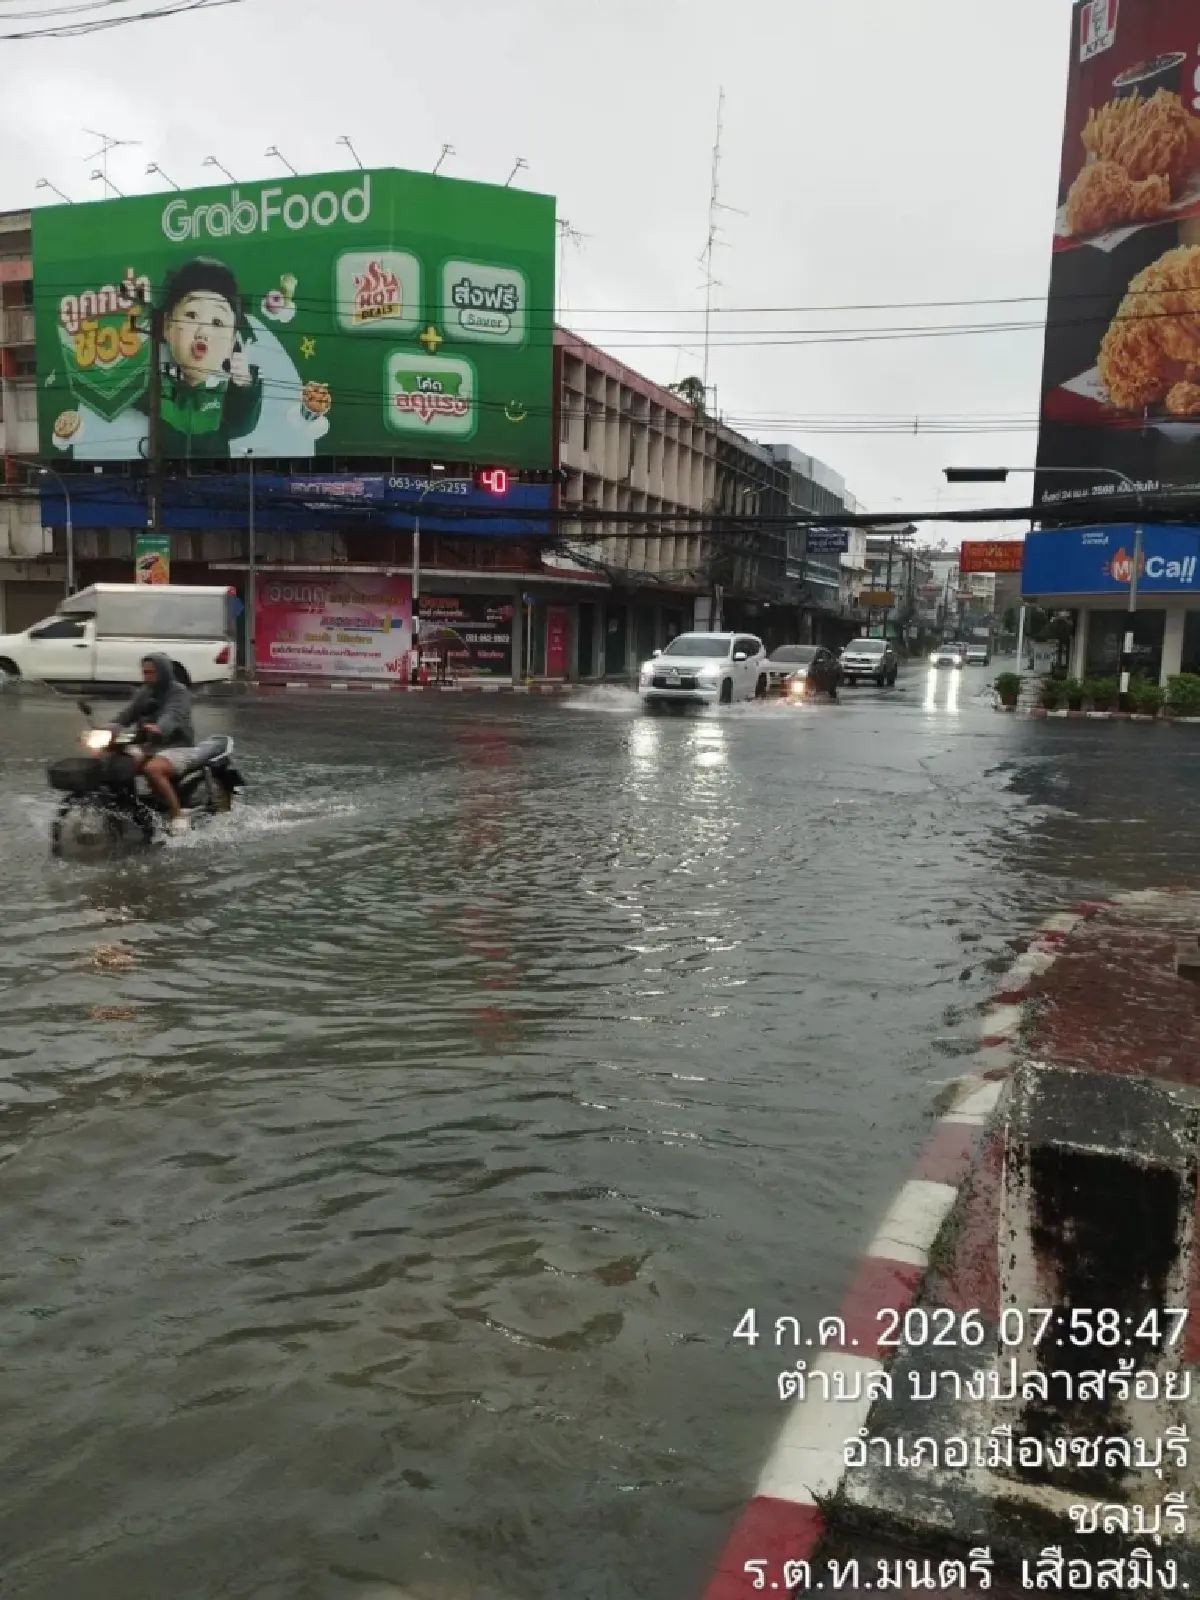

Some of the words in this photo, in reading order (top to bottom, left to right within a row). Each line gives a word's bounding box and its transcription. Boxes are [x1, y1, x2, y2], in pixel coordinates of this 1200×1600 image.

[162, 174, 371, 242] GrabFood
[360, 289, 396, 308] HOT
[453, 279, 517, 313] ส่งฟรี
[482, 469, 506, 493] 40
